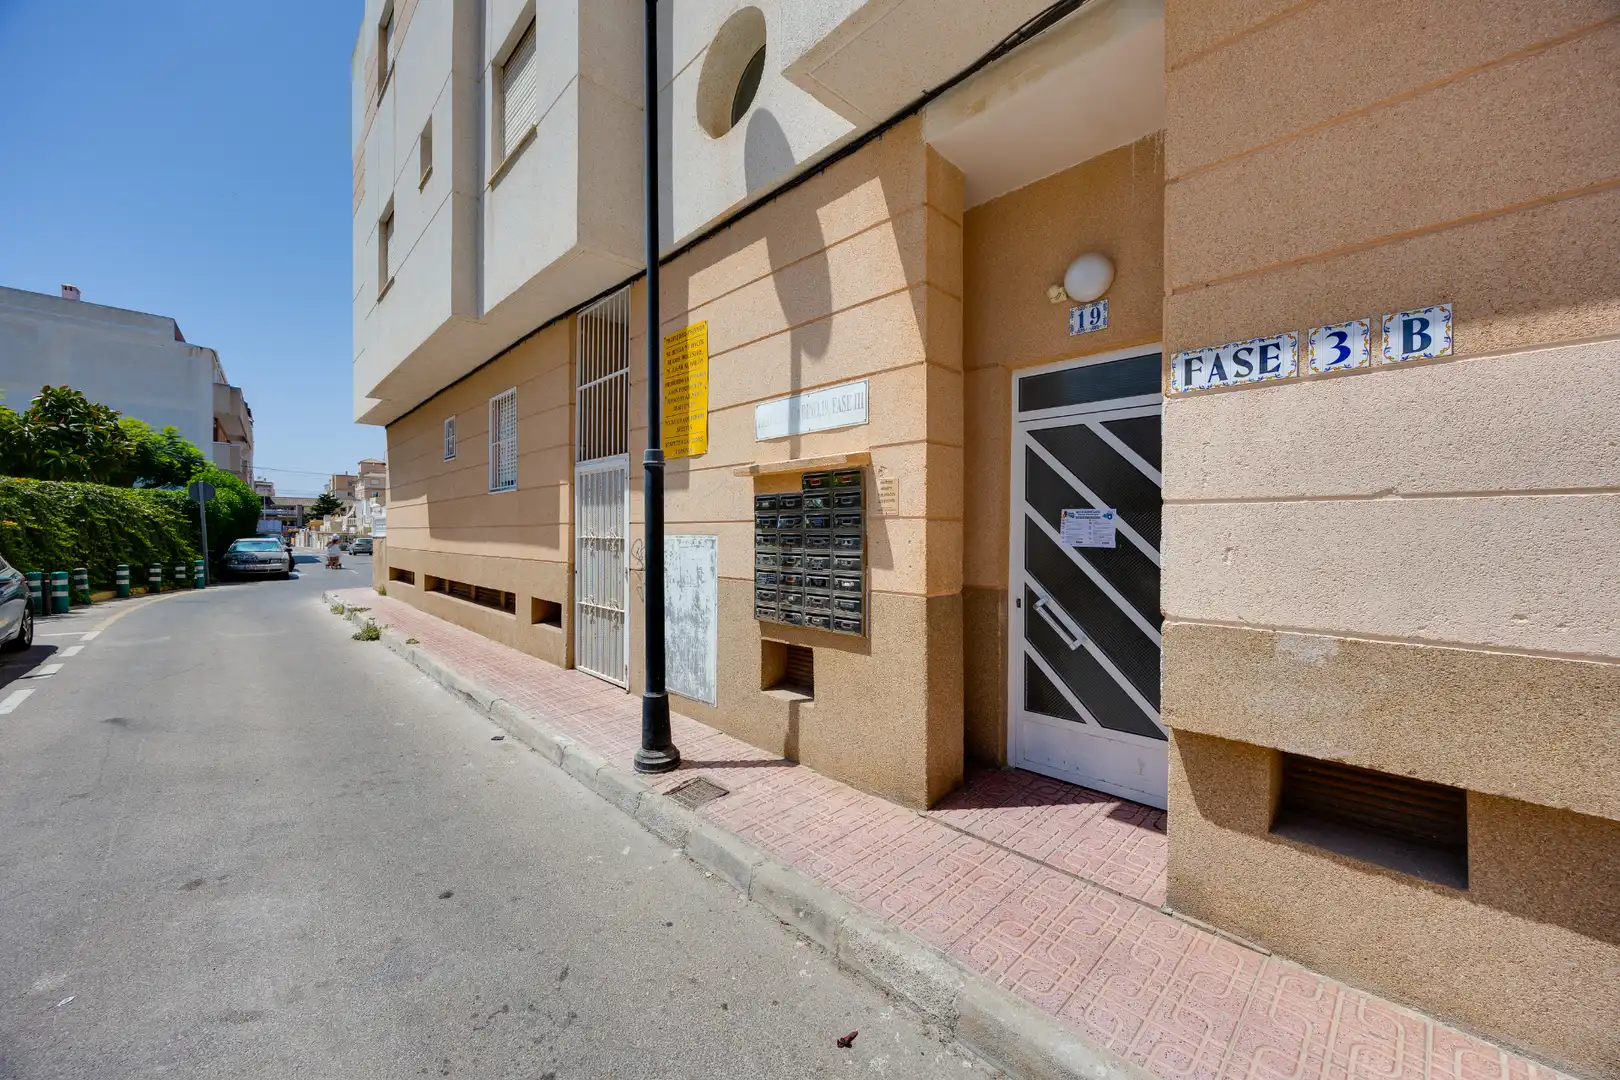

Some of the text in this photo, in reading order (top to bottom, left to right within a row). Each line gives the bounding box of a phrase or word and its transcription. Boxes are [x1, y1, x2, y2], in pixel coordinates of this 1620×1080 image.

[1078, 306, 1101, 329] 19
[1183, 317, 1432, 386] FASE 3 B
[832, 394, 852, 414] FASE
[854, 391, 865, 411] III
